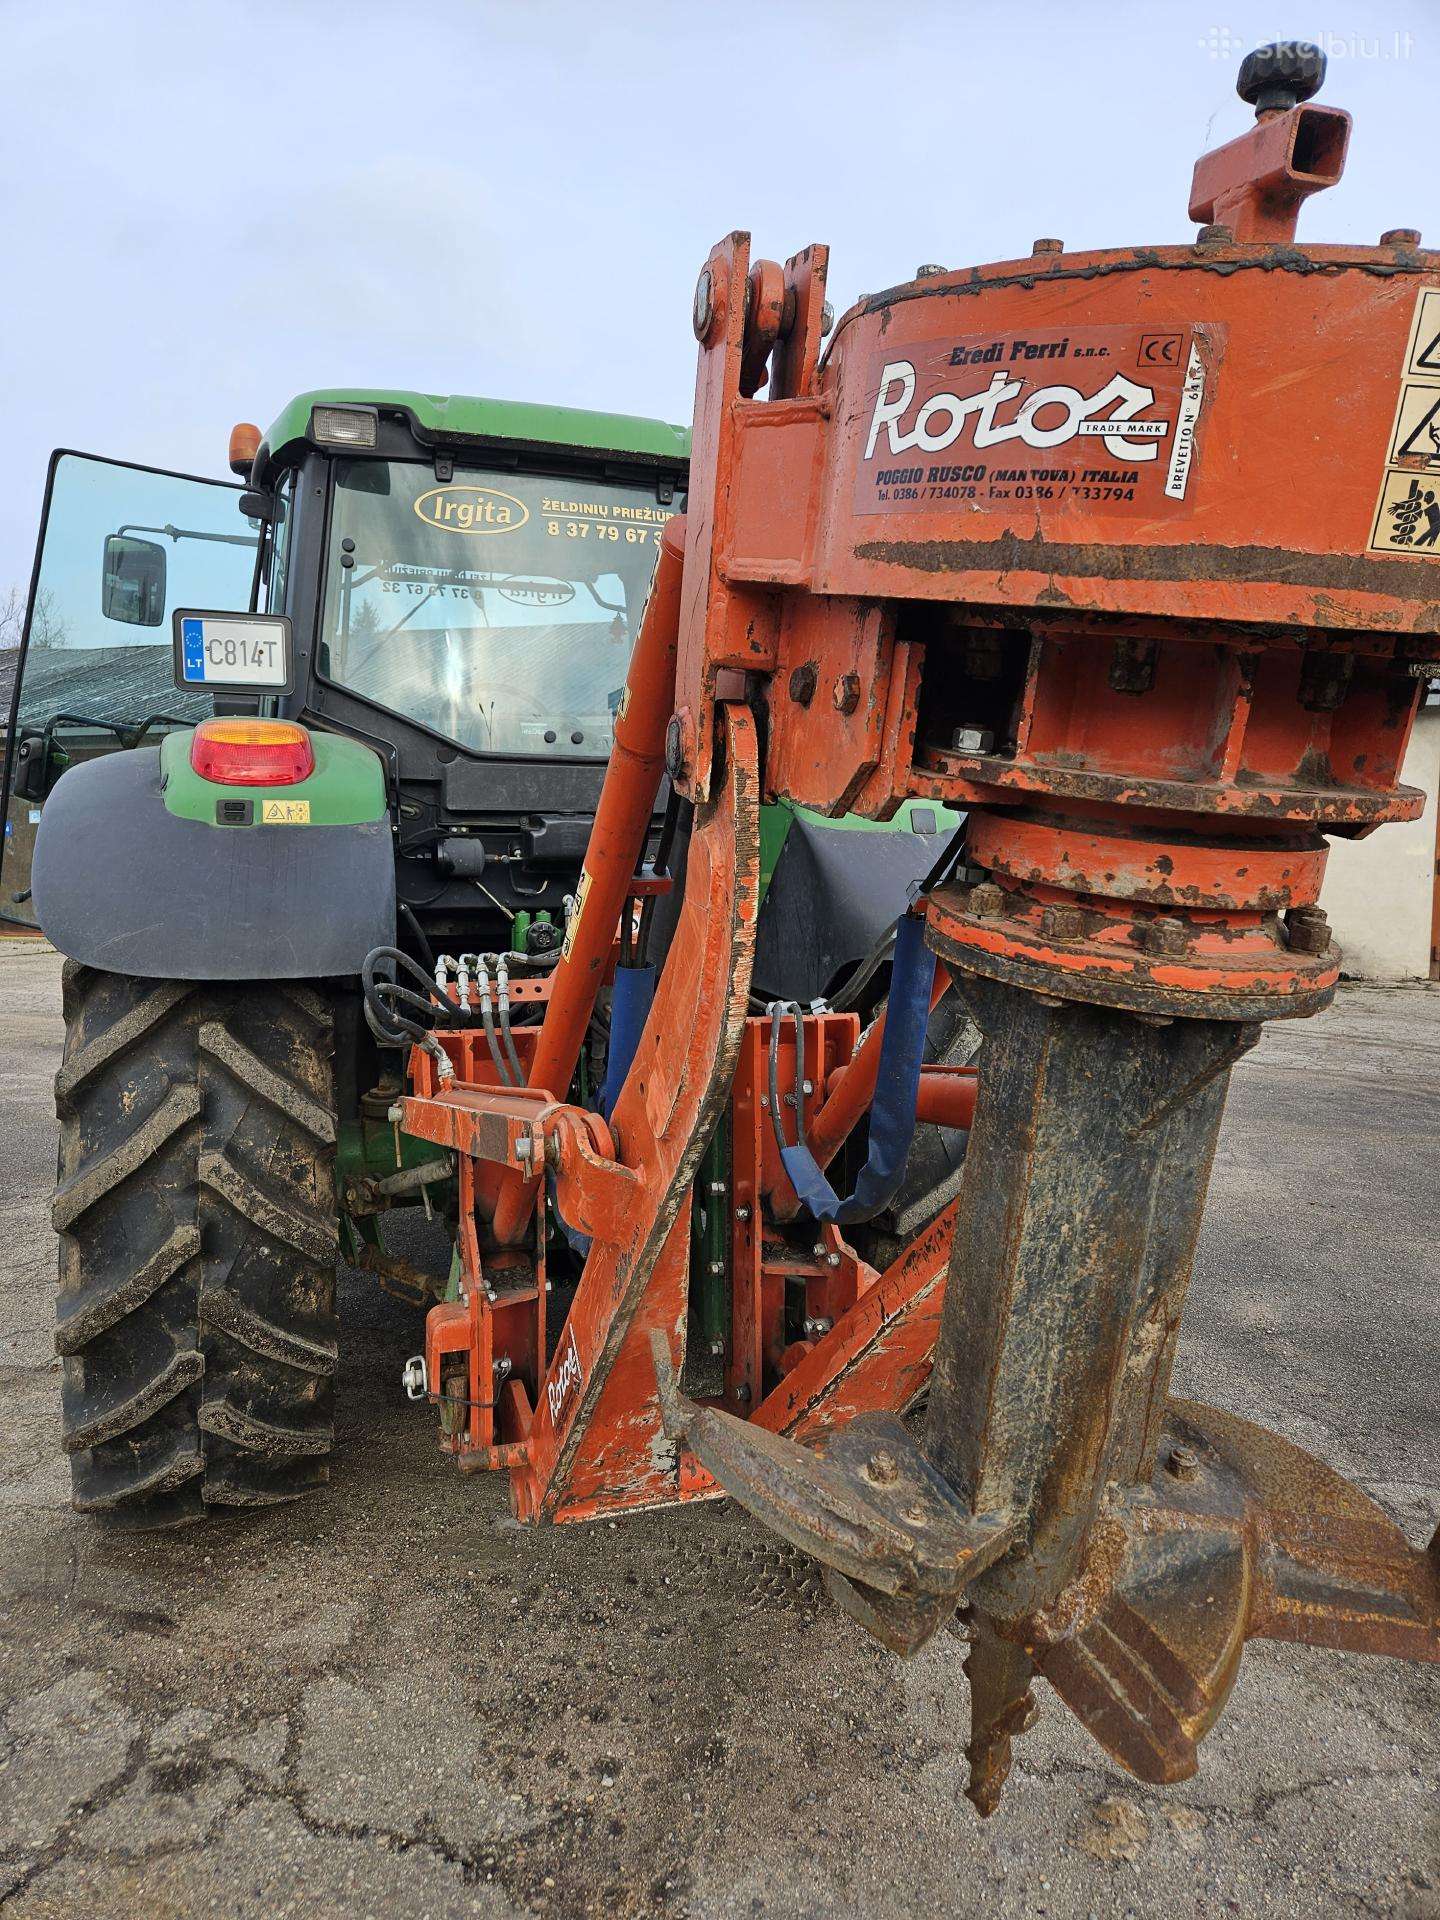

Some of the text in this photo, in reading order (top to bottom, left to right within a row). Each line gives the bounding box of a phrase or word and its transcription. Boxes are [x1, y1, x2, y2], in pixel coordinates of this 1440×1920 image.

[949, 338, 1110, 366] Eredi Ferri s.n.c.
[1145, 340, 1176, 361] CE
[1086, 424, 1162, 433] TRADE MARK
[1171, 429, 1192, 490] BREVETTO
[1184, 407, 1195, 423] N°
[876, 467, 924, 486] POGGIO
[927, 464, 987, 483] RUSCO
[1081, 470, 1139, 484] ITALIA
[878, 489, 891, 500] Tel.
[893, 488, 919, 500] 0386
[929, 486, 977, 499] 734078
[989, 487, 1010, 499] Fax
[1015, 486, 1054, 499] 0386
[434, 495, 511, 528] Irgita
[542, 497, 609, 518] ŽELDINIŲ
[548, 520, 560, 536] 8
[566, 521, 589, 538] 37
[596, 524, 619, 542] 79
[625, 527, 648, 544] 67
[187, 658, 202, 668] LT
[208, 638, 277, 668] C814T
